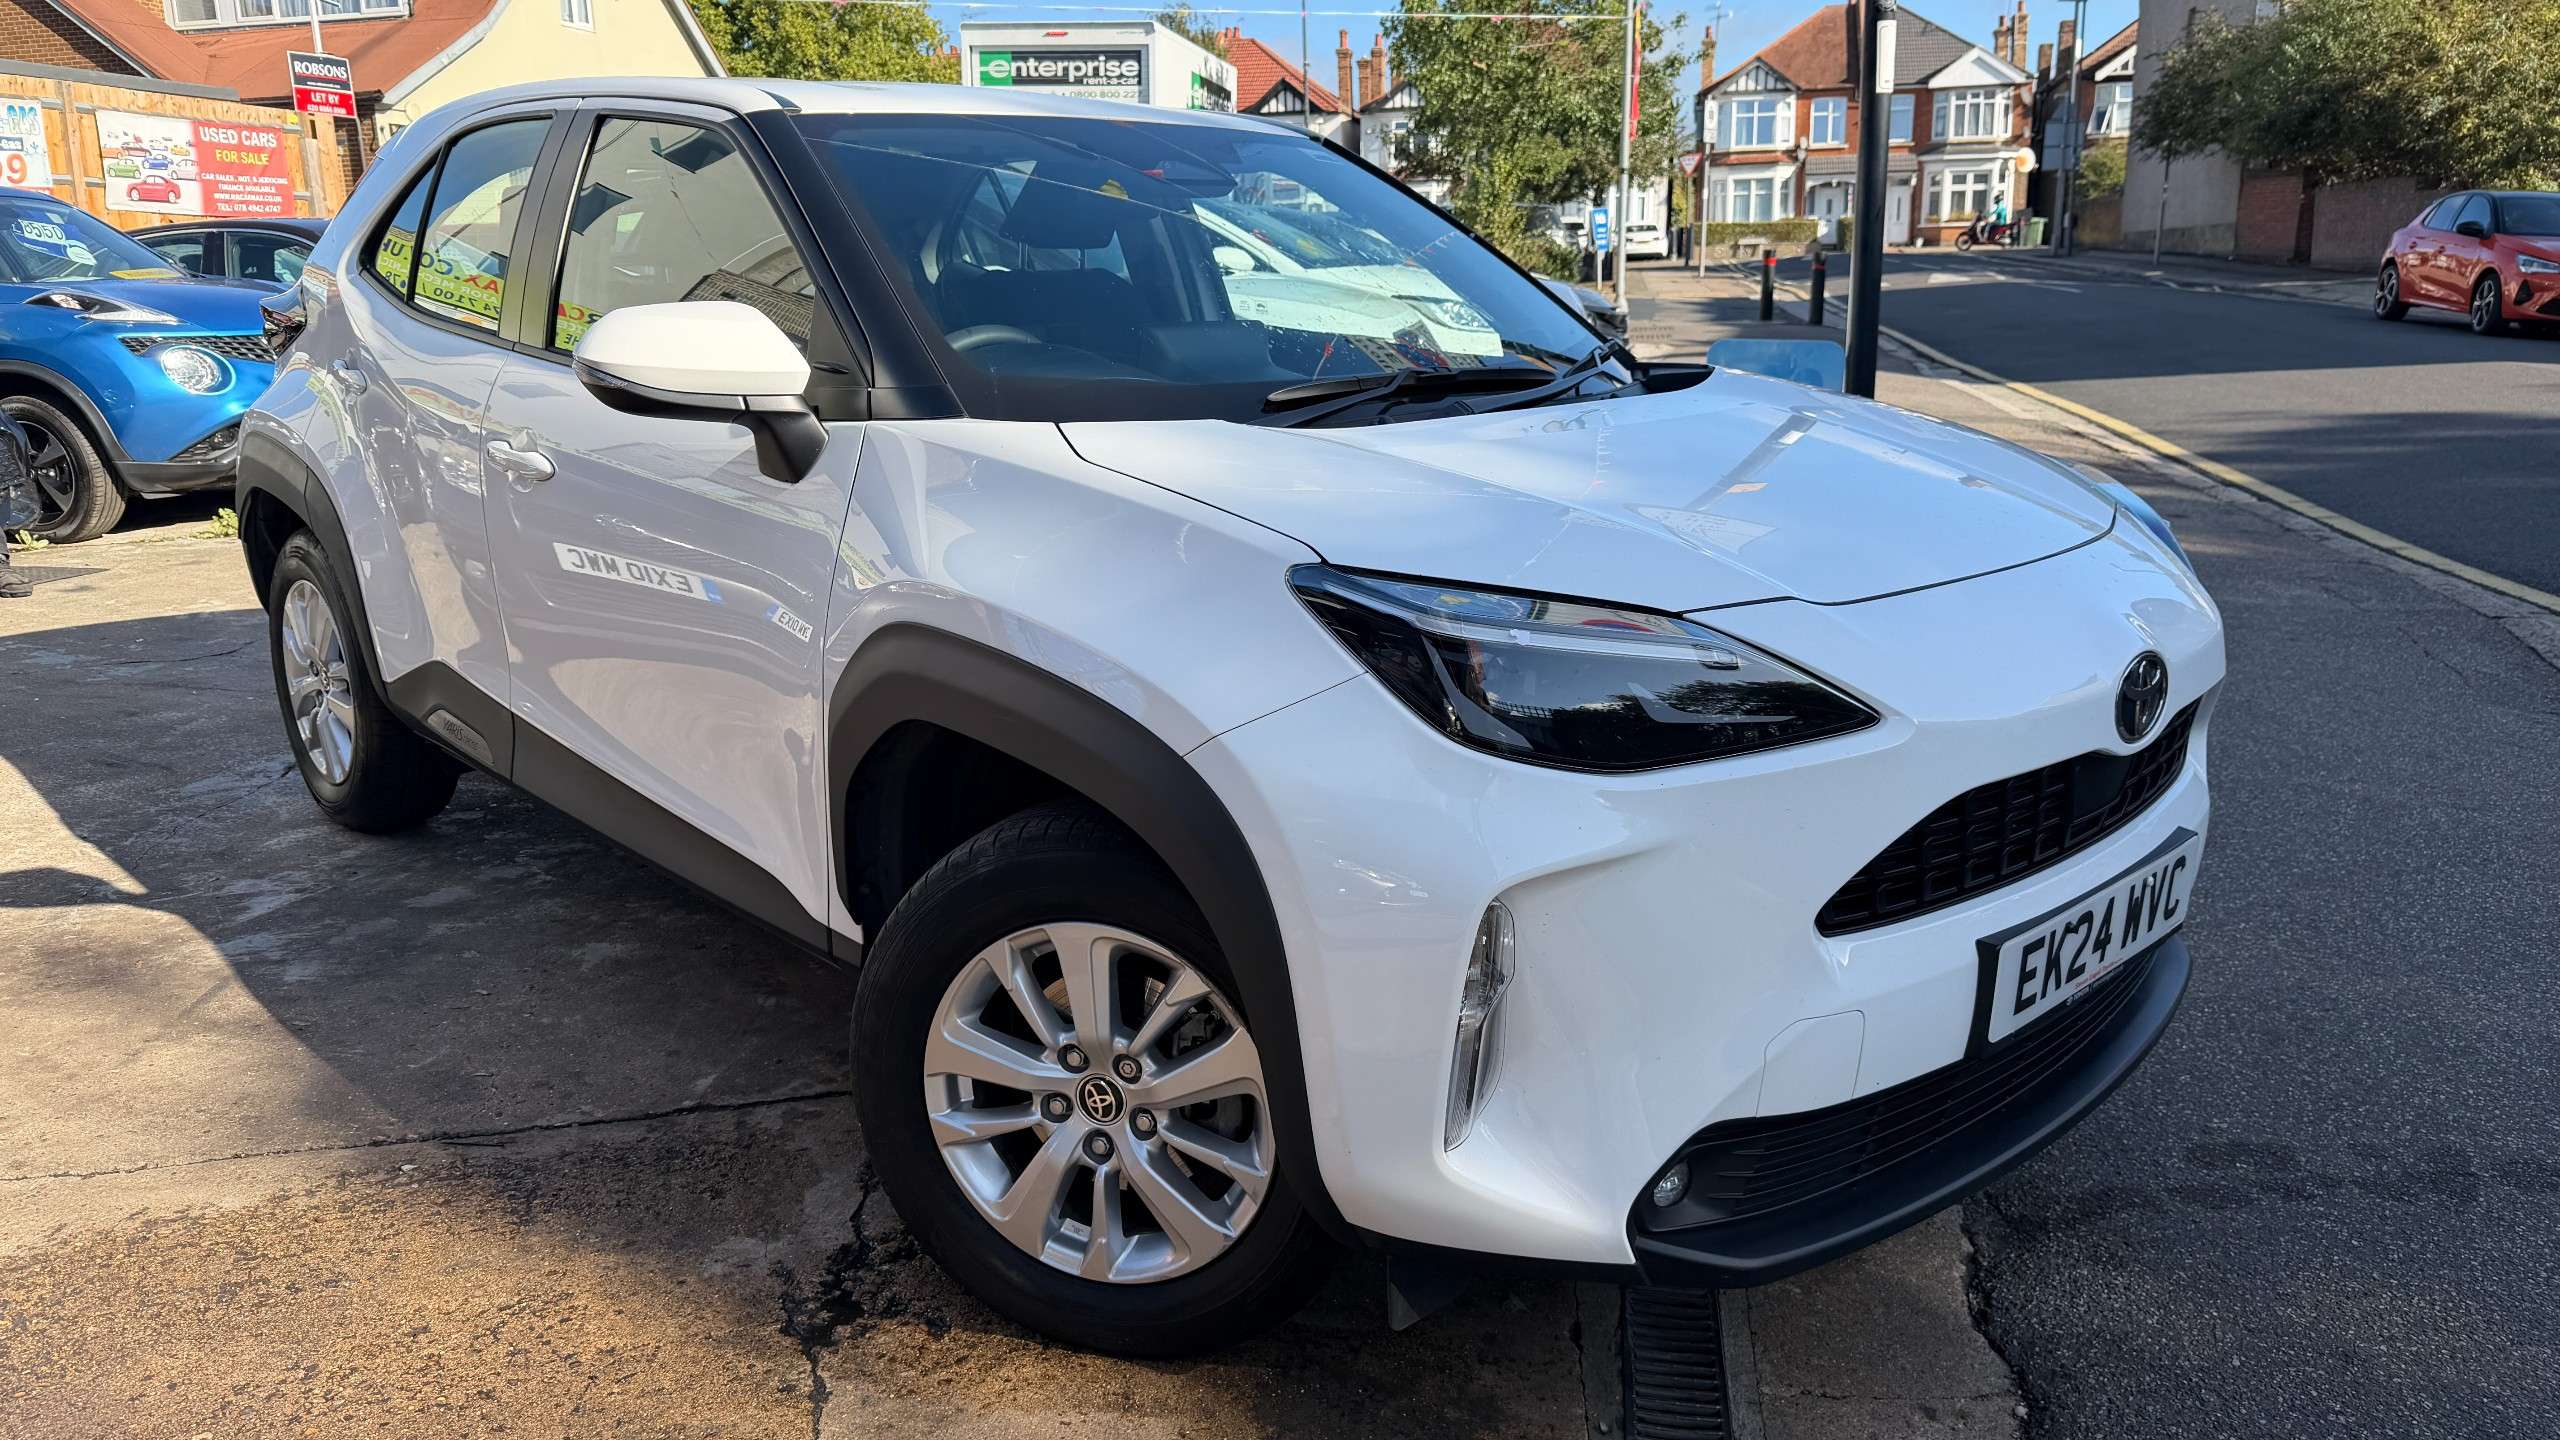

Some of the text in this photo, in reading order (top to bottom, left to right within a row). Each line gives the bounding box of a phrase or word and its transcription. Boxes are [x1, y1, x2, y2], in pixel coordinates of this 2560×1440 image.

[293, 60, 348, 79] ROBSONS
[985, 55, 1140, 83] enterprise
[1082, 76, 1140, 86] rent-a-car
[310, 91, 340, 105] LET BY
[199, 126, 277, 148] USED CARS
[215, 149, 270, 165] FOR SALE
[442, 716, 464, 742] YARIS
[2012, 854, 2187, 1017] EK24 WVC
